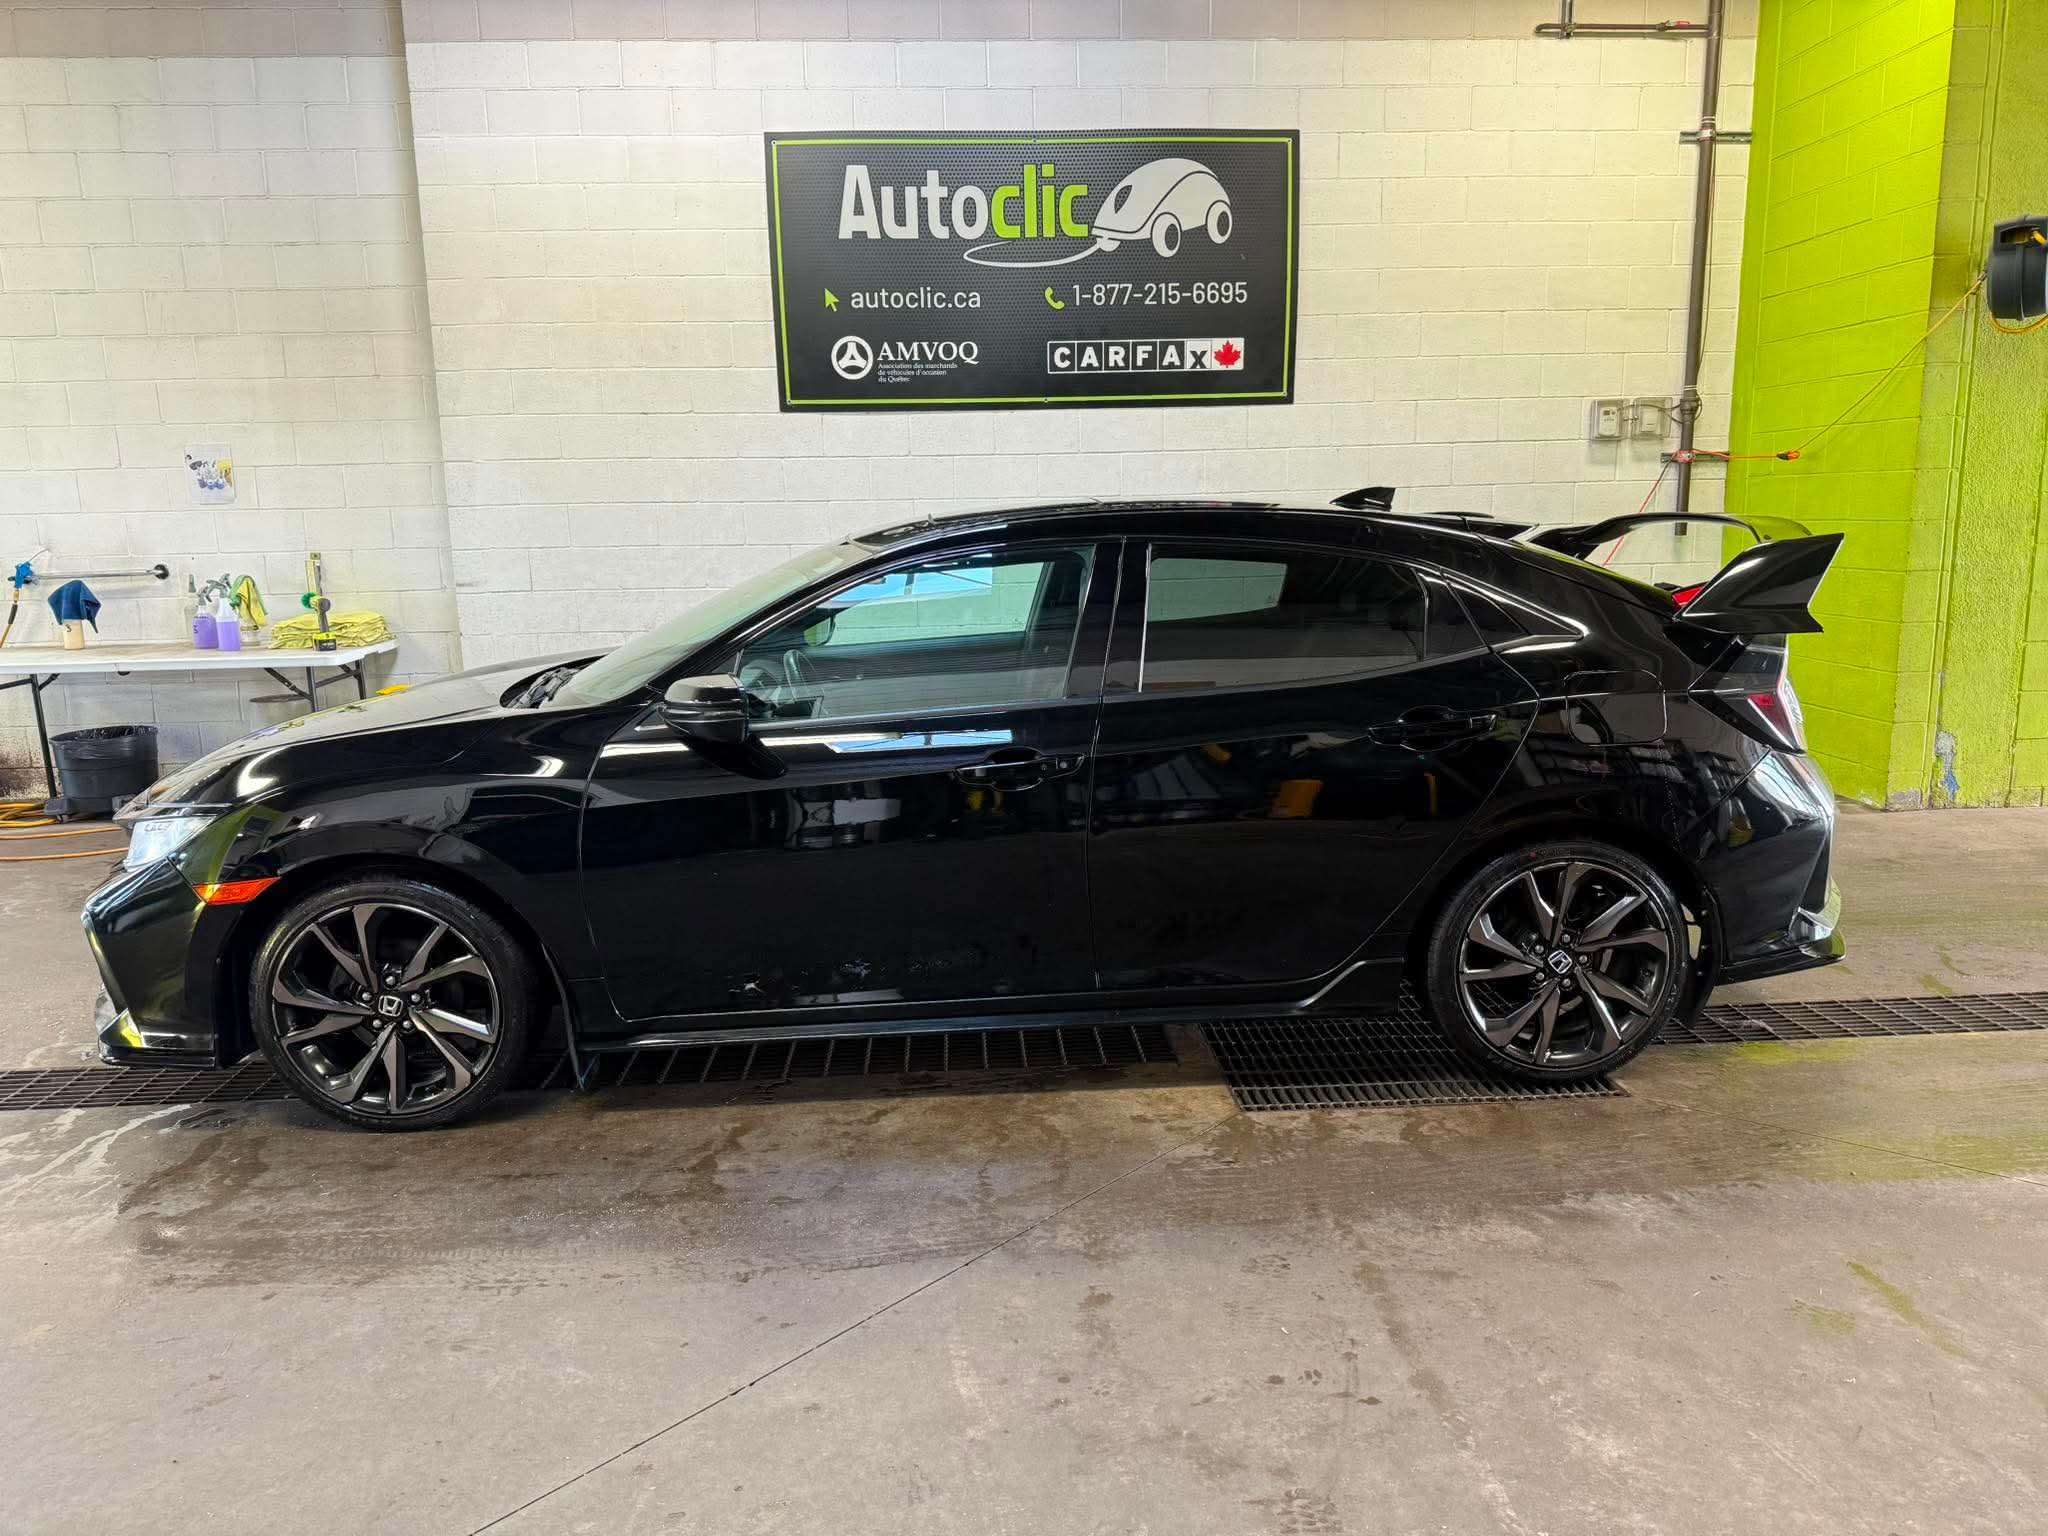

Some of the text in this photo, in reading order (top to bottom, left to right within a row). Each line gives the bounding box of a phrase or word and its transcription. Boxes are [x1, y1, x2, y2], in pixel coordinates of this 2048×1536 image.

[838, 163, 1089, 240] Autoclic
[850, 286, 981, 309] autoclic.ca
[1072, 281, 1248, 306] 1-877-215-6695
[877, 341, 980, 365] AMVOQ
